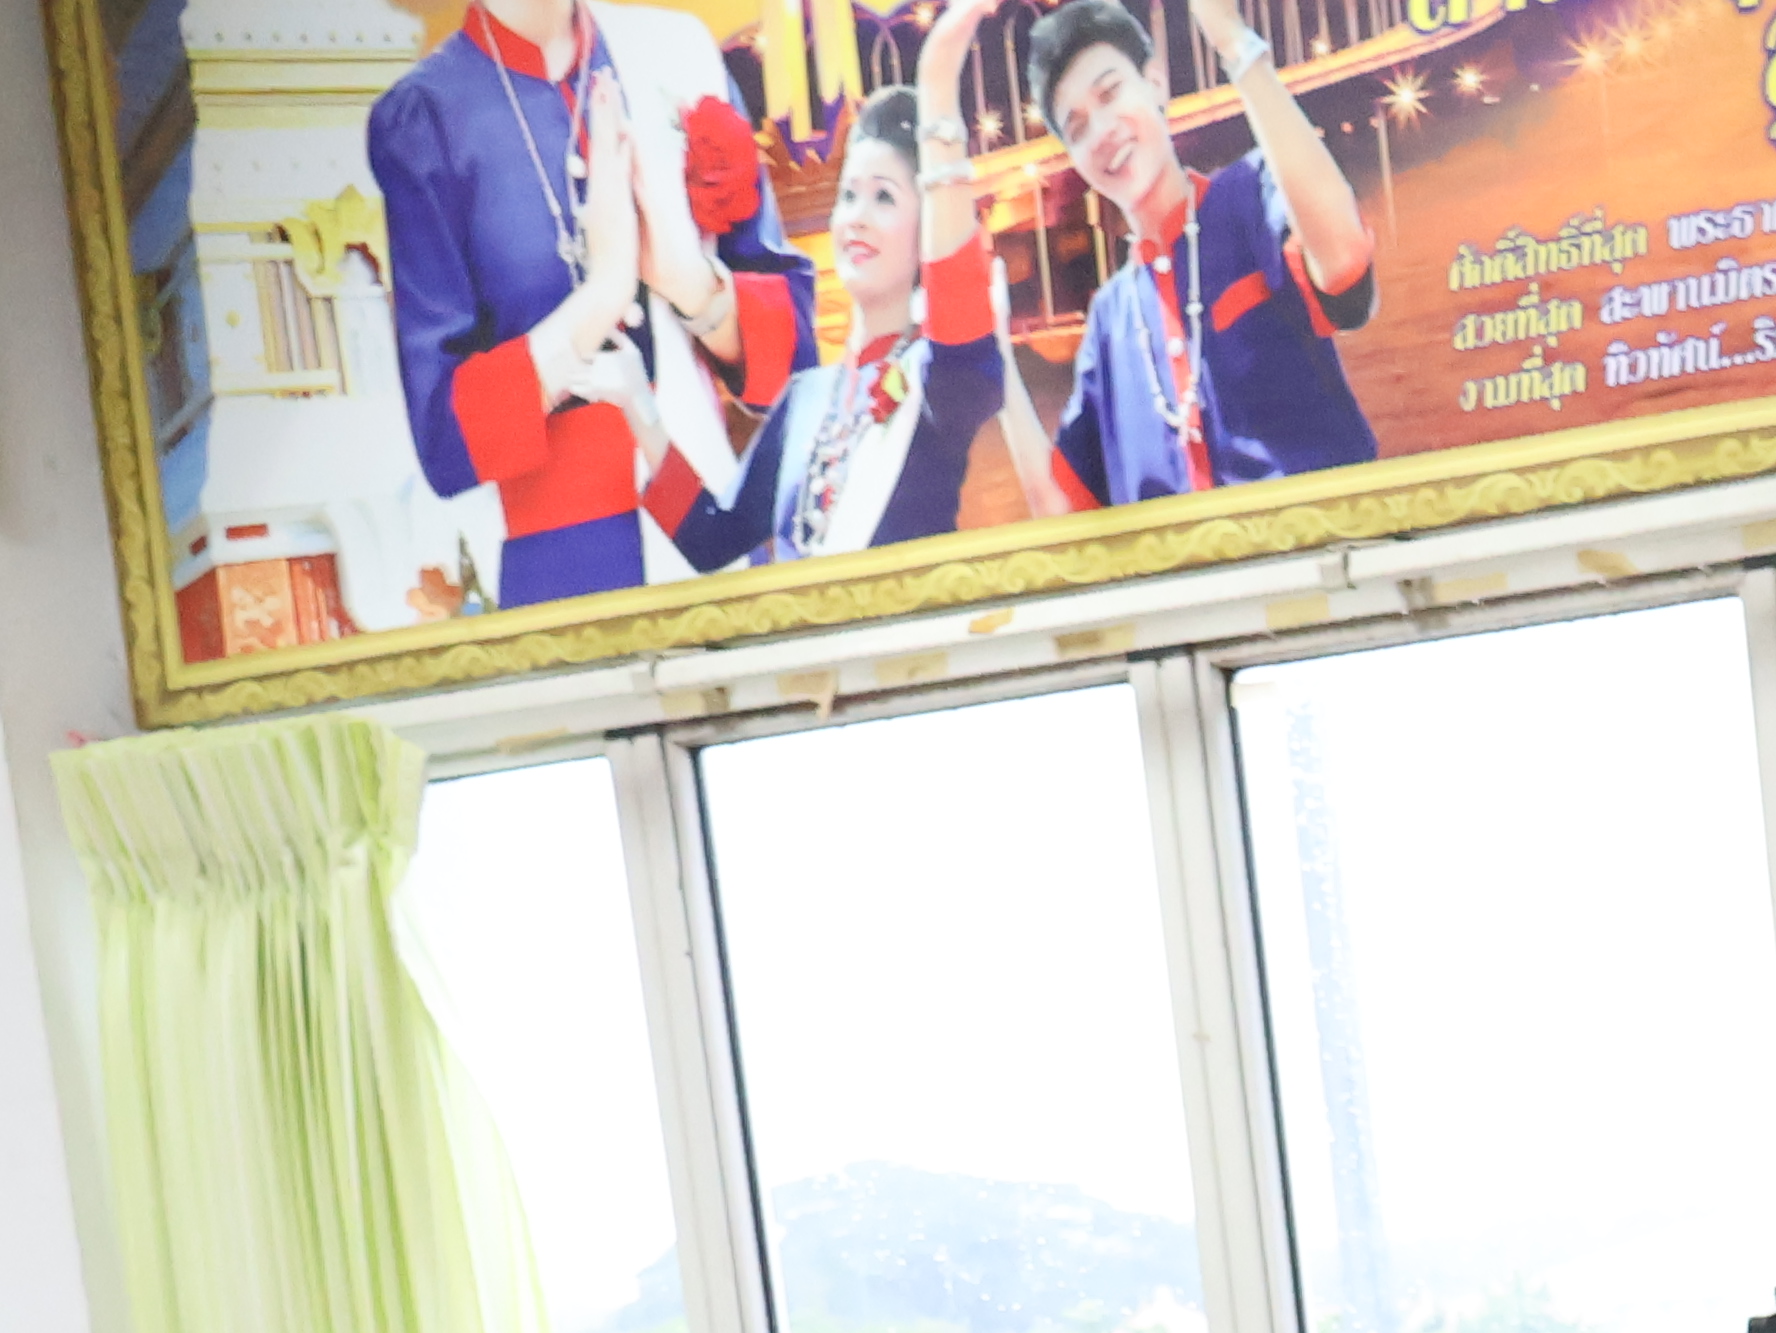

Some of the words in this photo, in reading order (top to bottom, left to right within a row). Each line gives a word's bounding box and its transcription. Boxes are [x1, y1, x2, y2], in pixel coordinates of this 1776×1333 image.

[1453, 282, 1583, 351] สวยที่สุด
[1459, 345, 1587, 411] งามที่สุด
